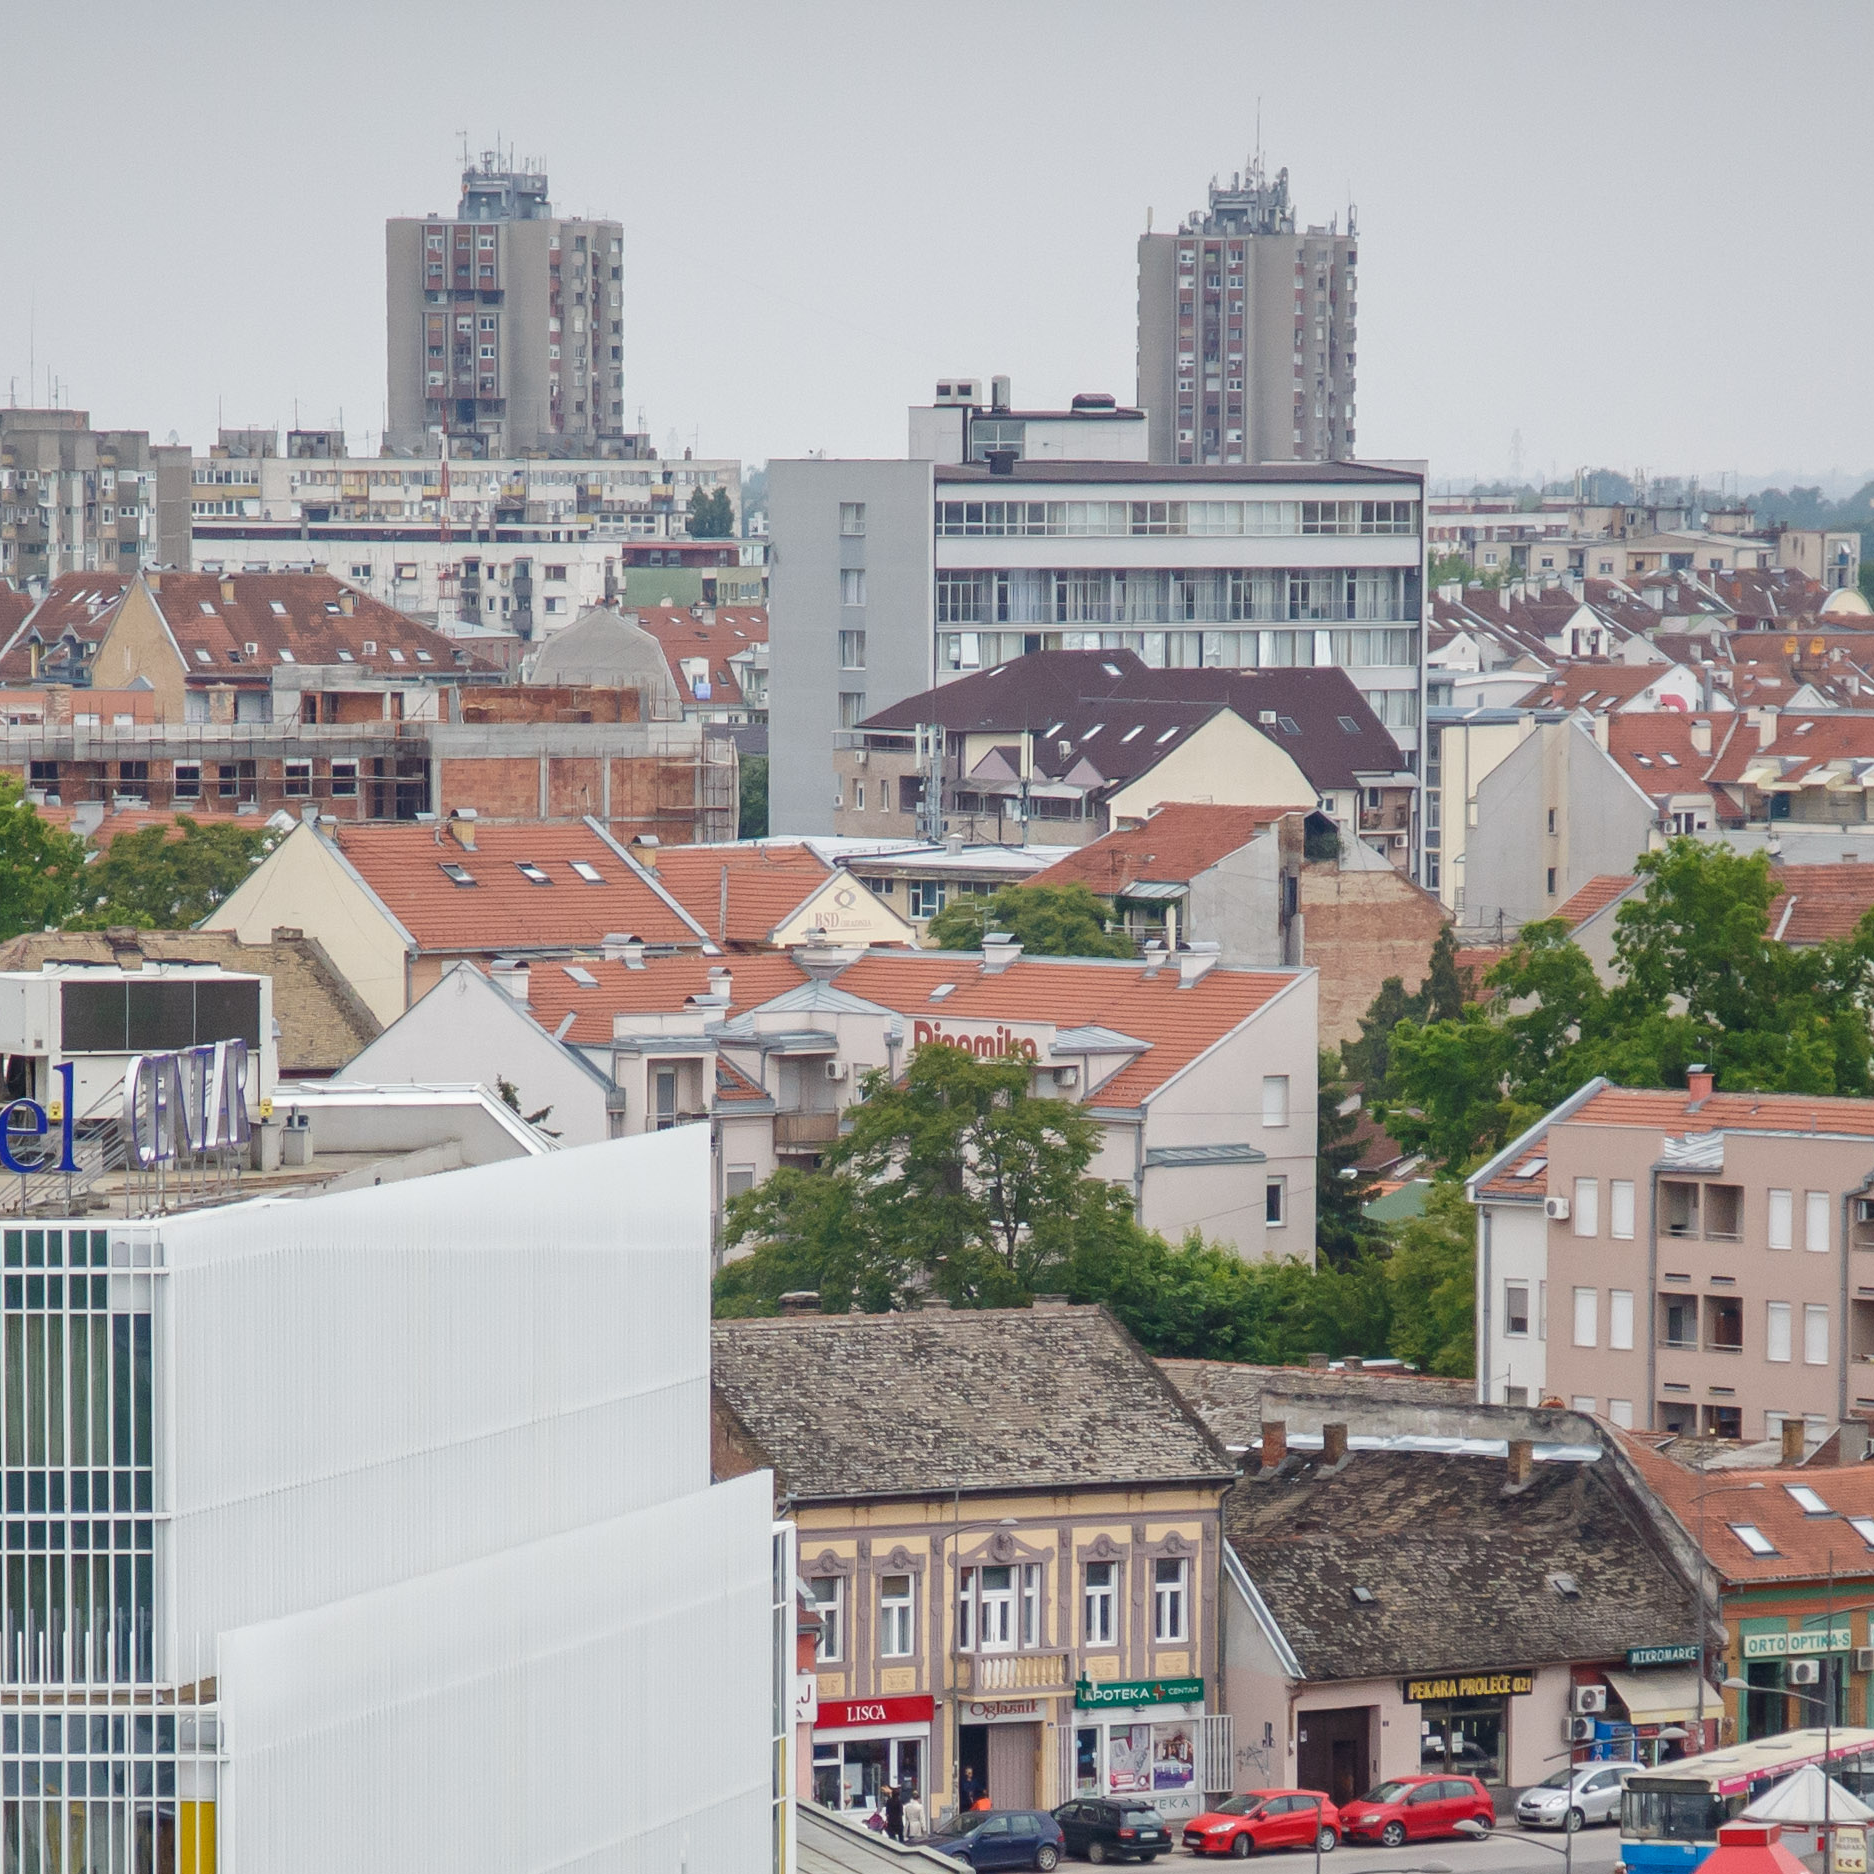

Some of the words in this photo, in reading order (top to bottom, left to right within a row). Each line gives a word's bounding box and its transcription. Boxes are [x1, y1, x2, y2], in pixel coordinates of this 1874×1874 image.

[1631, 1646, 1700, 1664] MIKROMARKE
[1748, 1640, 1786, 1654] ORTO
[1408, 1680, 1457, 1700] PEKARA
[846, 1704, 887, 1723] LISCA
